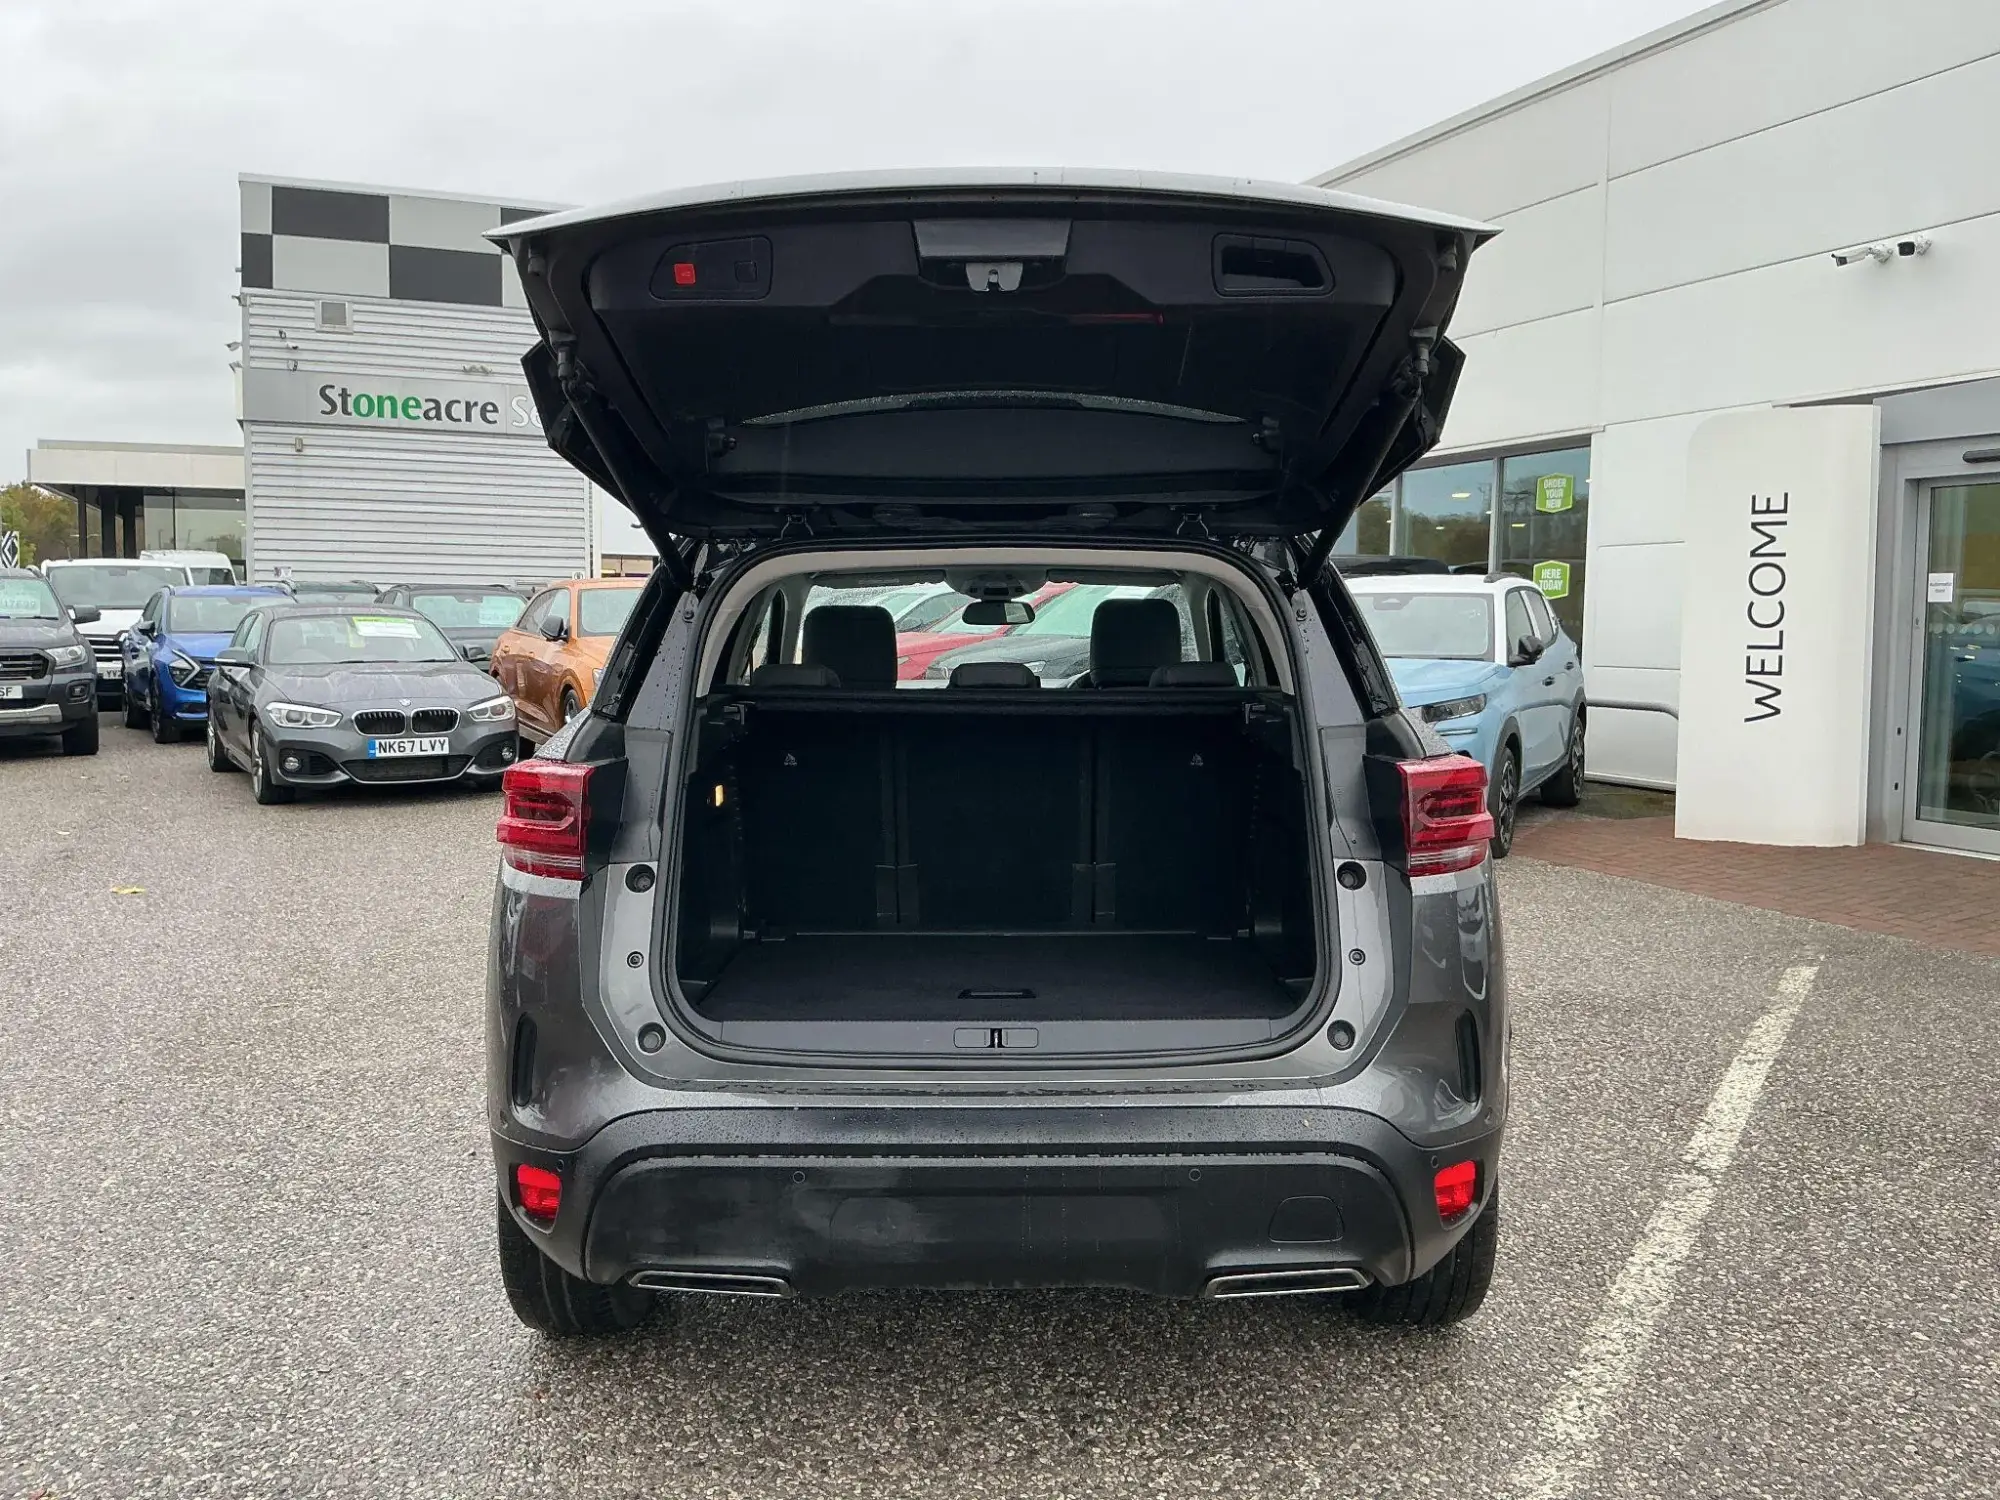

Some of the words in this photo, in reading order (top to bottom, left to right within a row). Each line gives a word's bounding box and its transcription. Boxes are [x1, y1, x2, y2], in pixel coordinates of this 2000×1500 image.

[319, 384, 500, 425] Stoneacre
[1545, 488, 1564, 499] YOUR
[1541, 568, 1562, 579] HERE
[1539, 579, 1563, 591] TODAY
[1744, 492, 1789, 723] WELCOME
[378, 741, 416, 754] NK67
[419, 739, 446, 752] LVY
